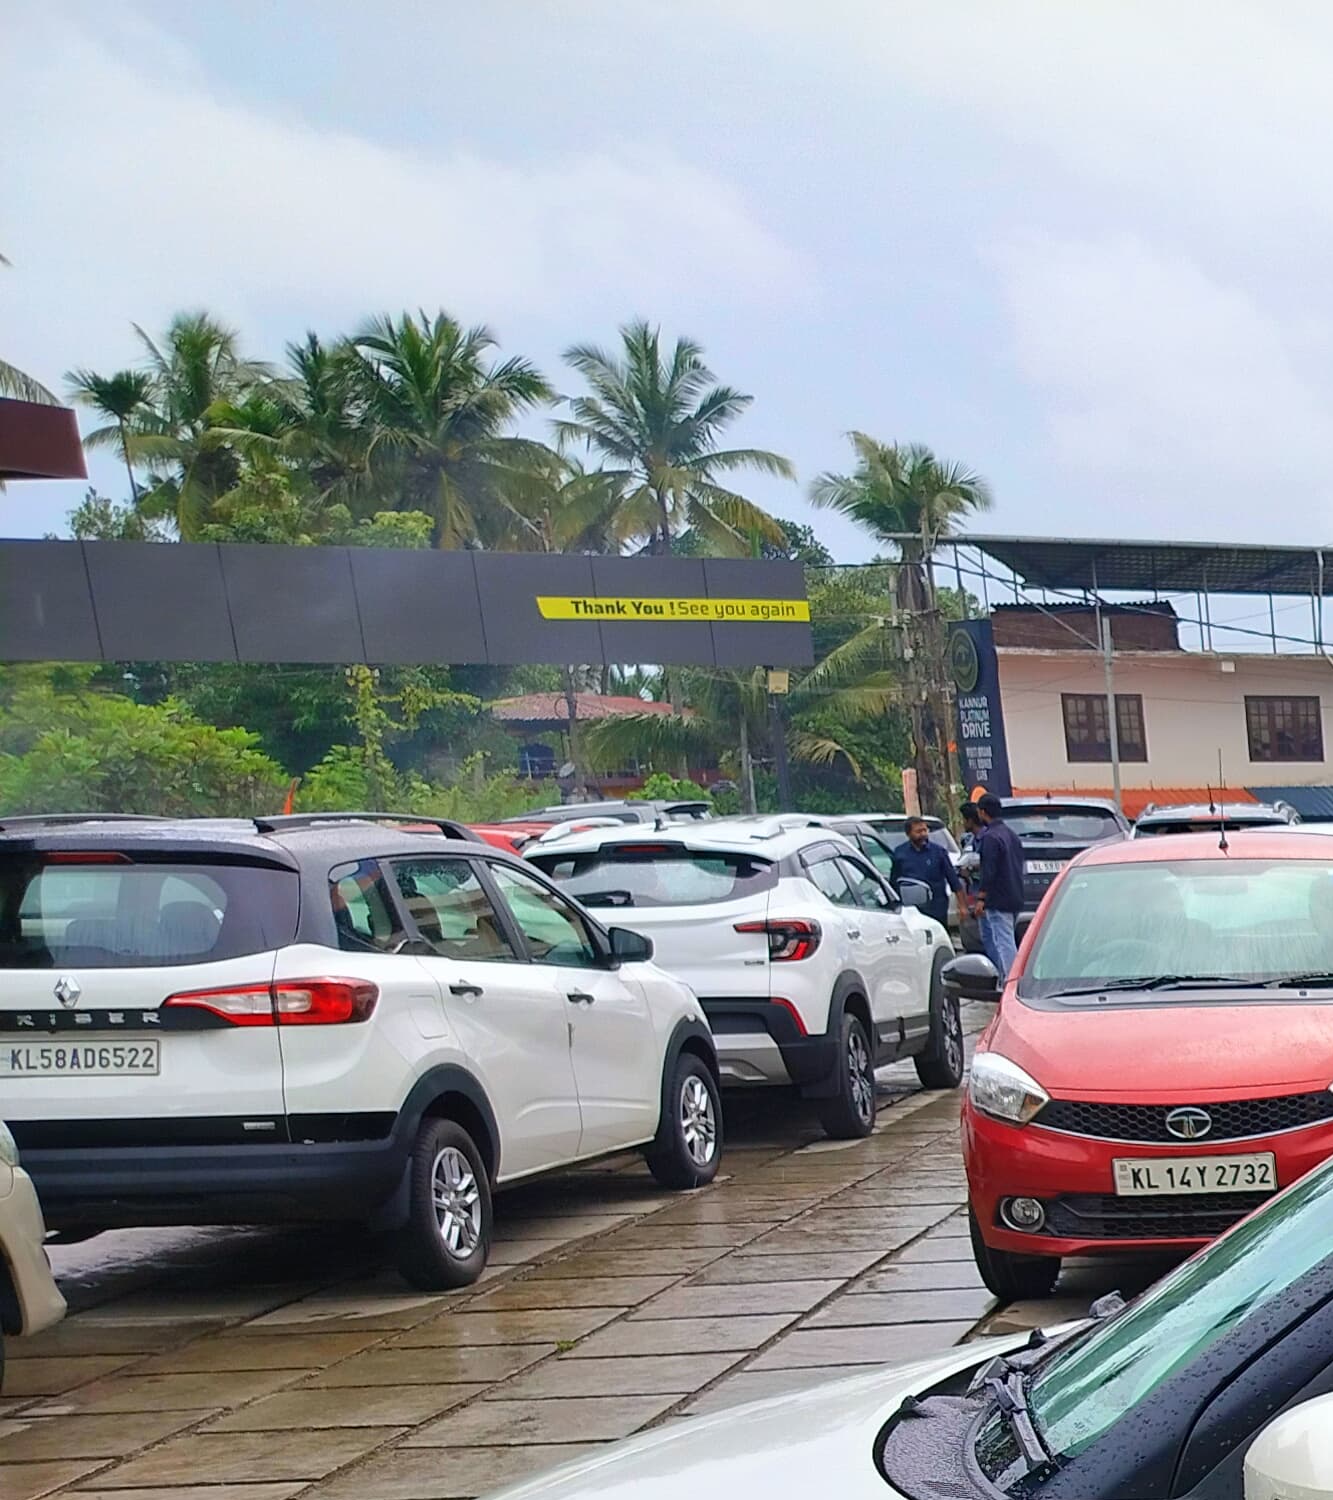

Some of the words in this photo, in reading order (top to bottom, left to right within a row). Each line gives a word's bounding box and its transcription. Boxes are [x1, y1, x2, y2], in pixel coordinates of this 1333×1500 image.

[571, 600, 627, 615] Thank
[631, 601, 664, 615] You
[678, 602, 709, 615] See
[715, 604, 745, 619] you
[750, 602, 796, 619] again
[959, 696, 988, 709] KANNUR
[960, 710, 990, 722] PLATINUM
[962, 722, 991, 738] DRIVE
[11, 1047, 155, 1070] KL58AD6522
[1131, 1167, 1159, 1190] KL
[1215, 1163, 1271, 1186] 2732
